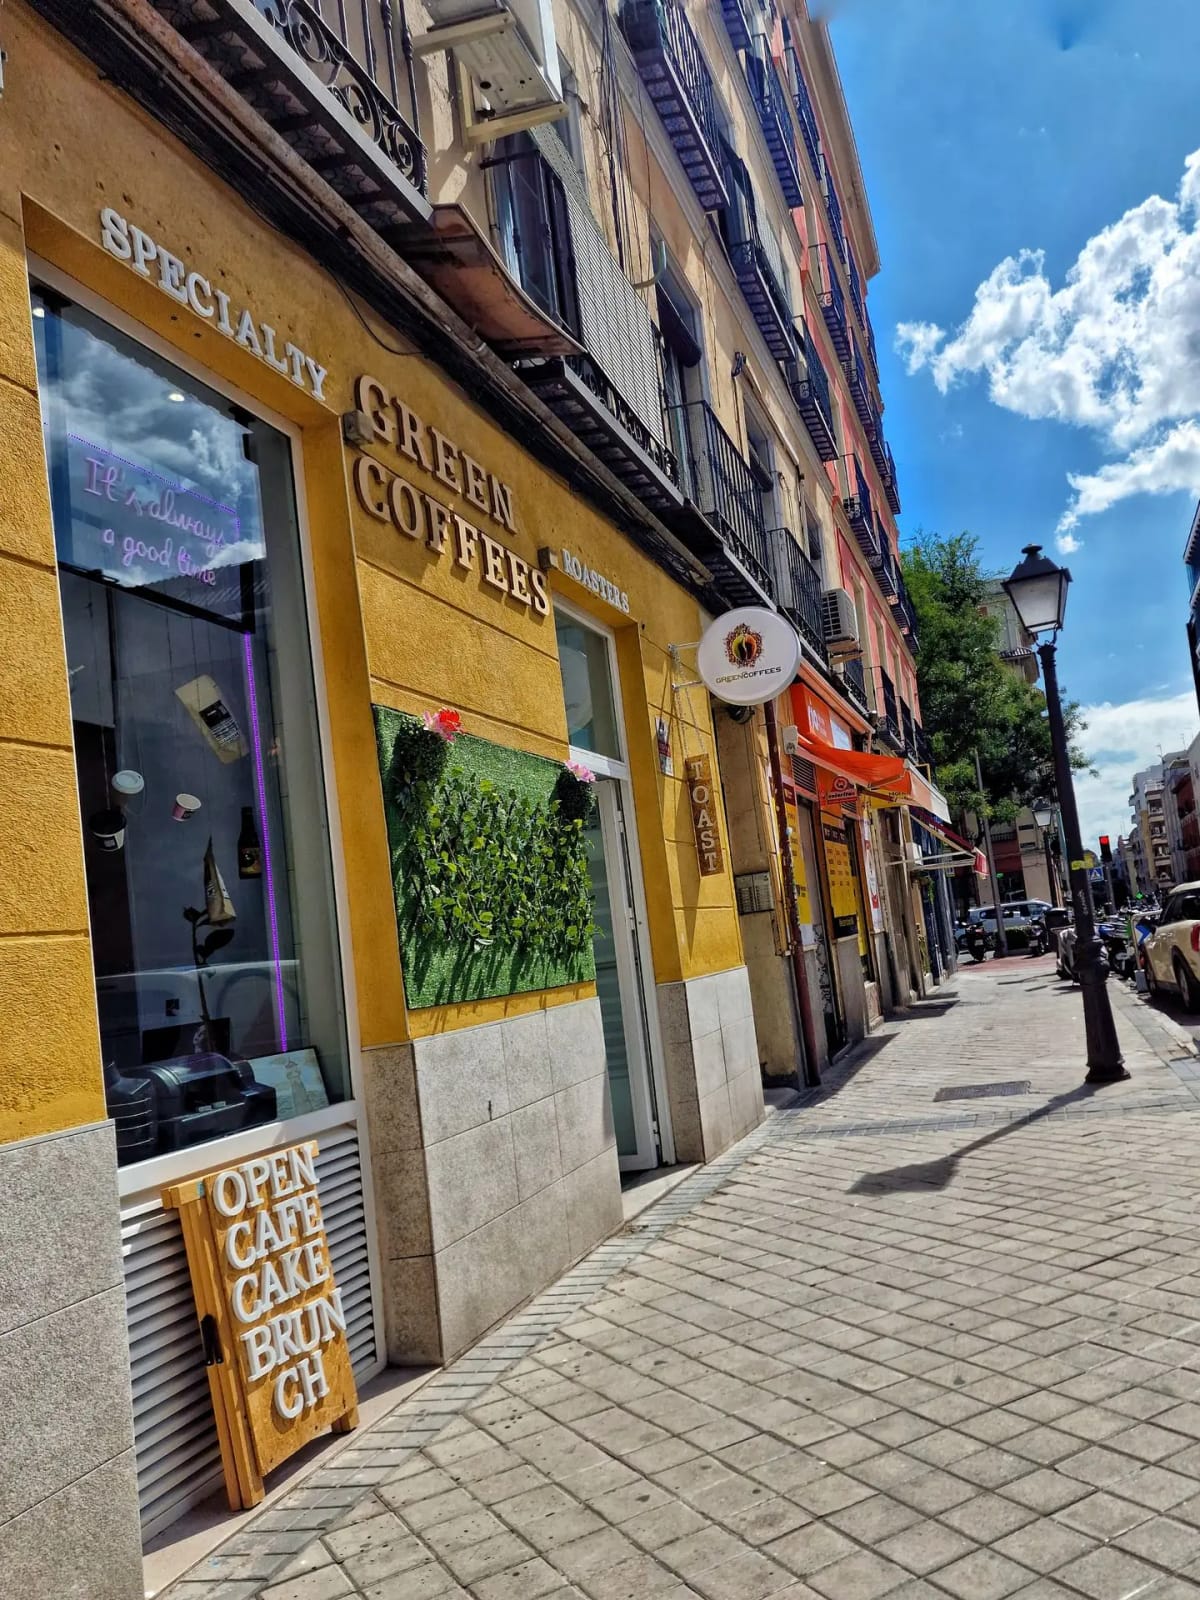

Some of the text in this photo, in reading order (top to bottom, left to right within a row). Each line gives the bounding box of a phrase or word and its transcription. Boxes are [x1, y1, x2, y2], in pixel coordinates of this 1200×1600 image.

[101, 208, 327, 401] SPECIALTY
[357, 375, 517, 534] GREEN
[102, 528, 217, 586] a good time
[147, 489, 225, 558] always
[353, 456, 551, 617] COFFEES
[561, 548, 630, 614] ROASTERS
[690, 761, 717, 872] TOAST
[213, 1143, 319, 1217] OPEN
[226, 1190, 325, 1270] CAFE
[232, 1238, 330, 1324] CAKE
[240, 1287, 348, 1383] BRUN
[274, 1350, 330, 1419] CH
